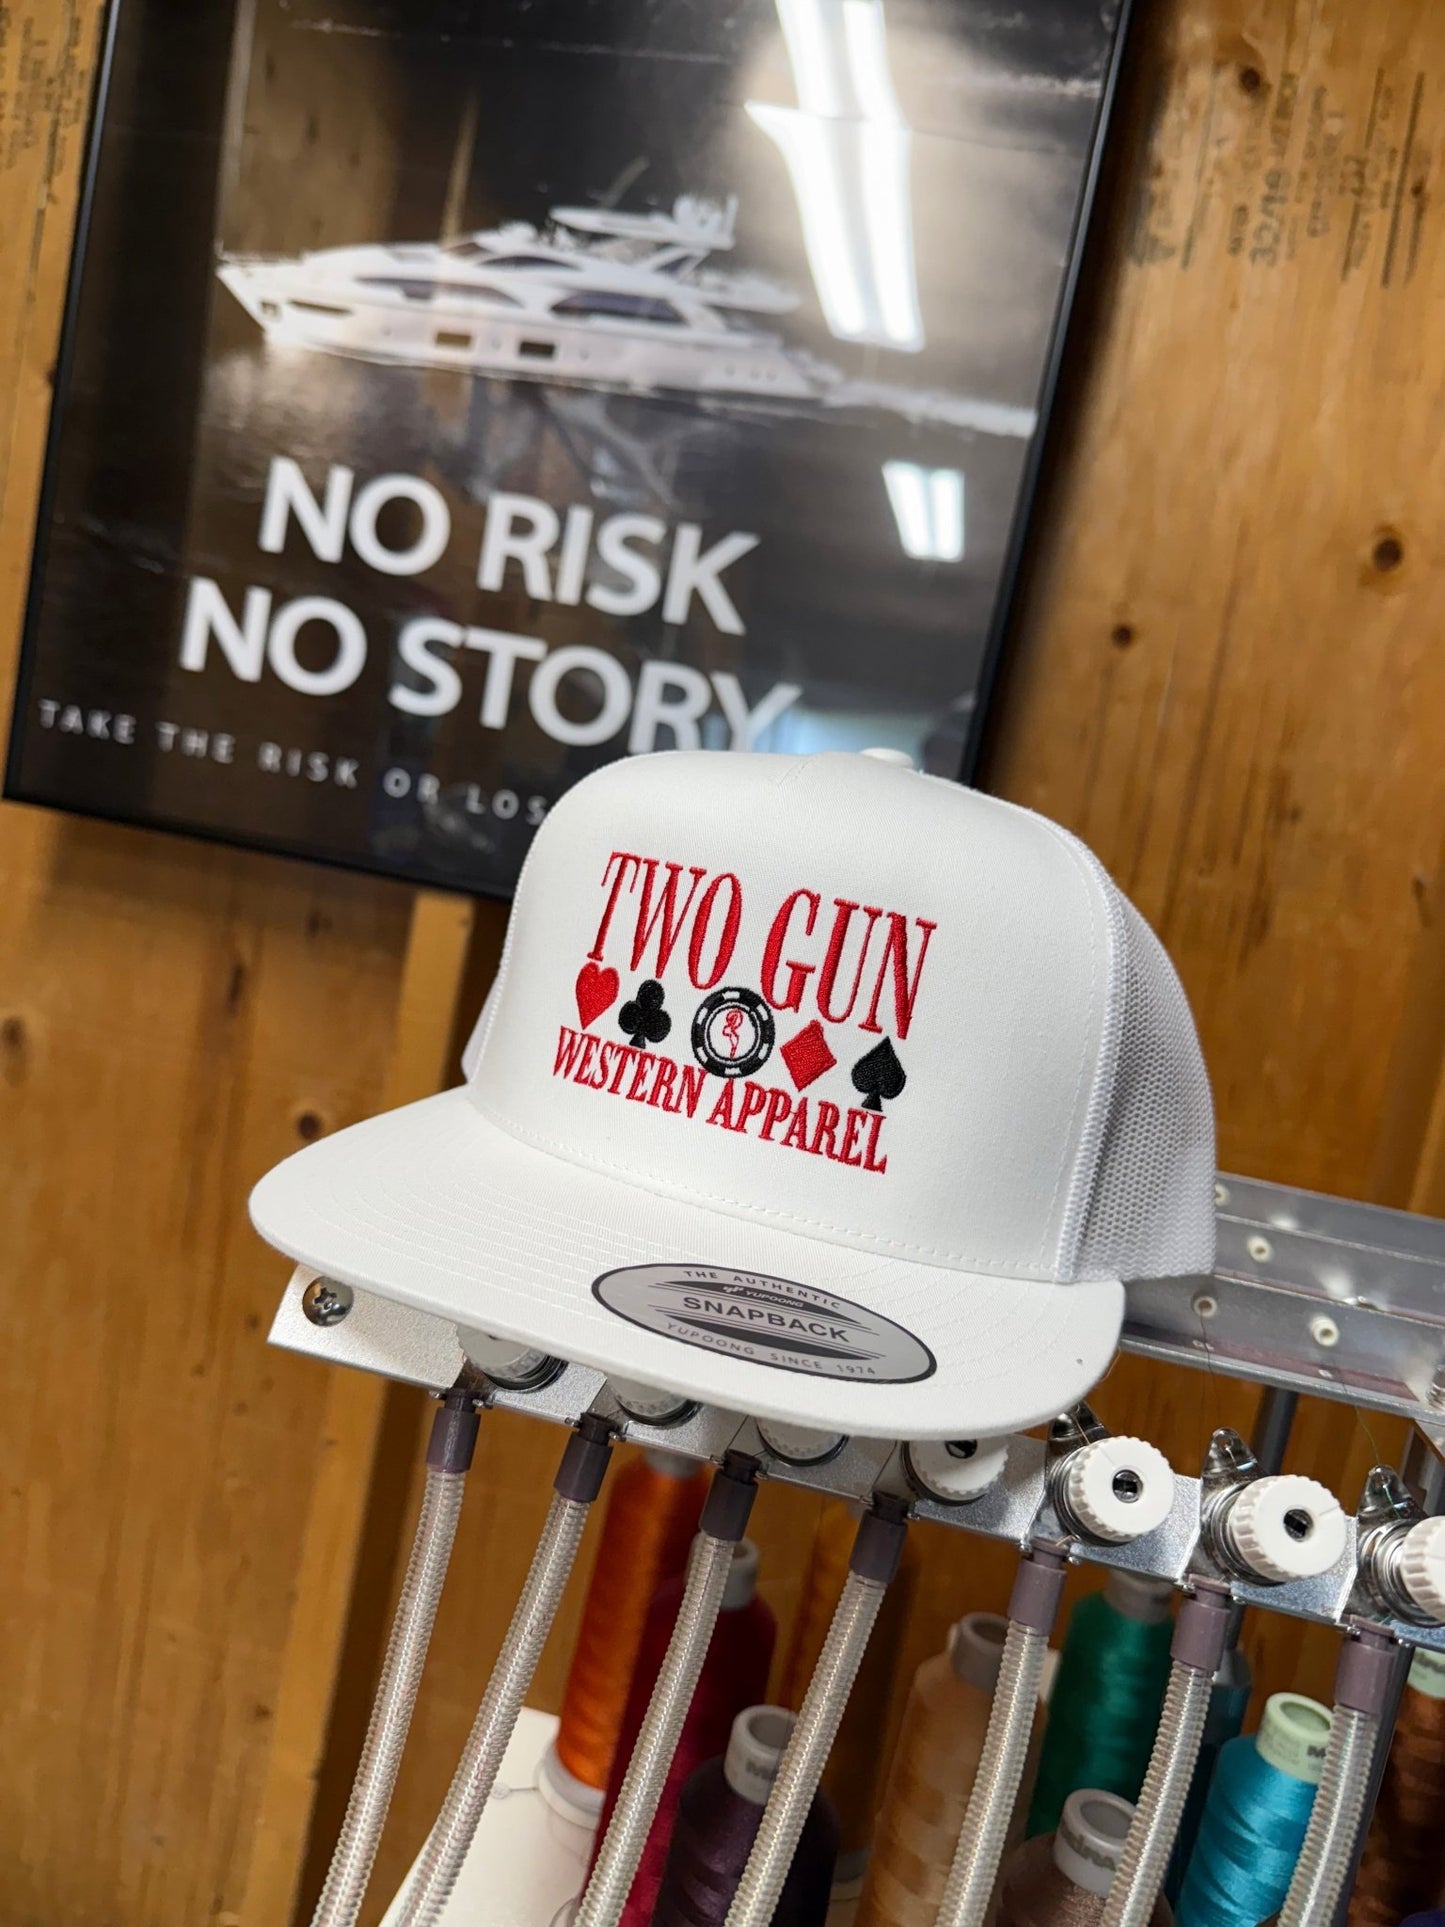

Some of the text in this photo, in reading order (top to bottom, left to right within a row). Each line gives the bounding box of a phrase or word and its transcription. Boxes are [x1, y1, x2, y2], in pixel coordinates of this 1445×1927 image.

[257, 457, 761, 636] NO RISK
[179, 577, 803, 755] NO STORY
[38, 698, 549, 826] TAKE THE RISK OR LOS
[587, 851, 938, 1040] TWO GUN
[553, 1025, 888, 1174] WESTERN APPAREL
[666, 1321, 876, 1376] YUPOONG SINCE 1974
[682, 1296, 850, 1343] SNAPBACK
[683, 1270, 842, 1309] THE AUTHENTIC
[745, 1290, 805, 1308] YUPOONG
